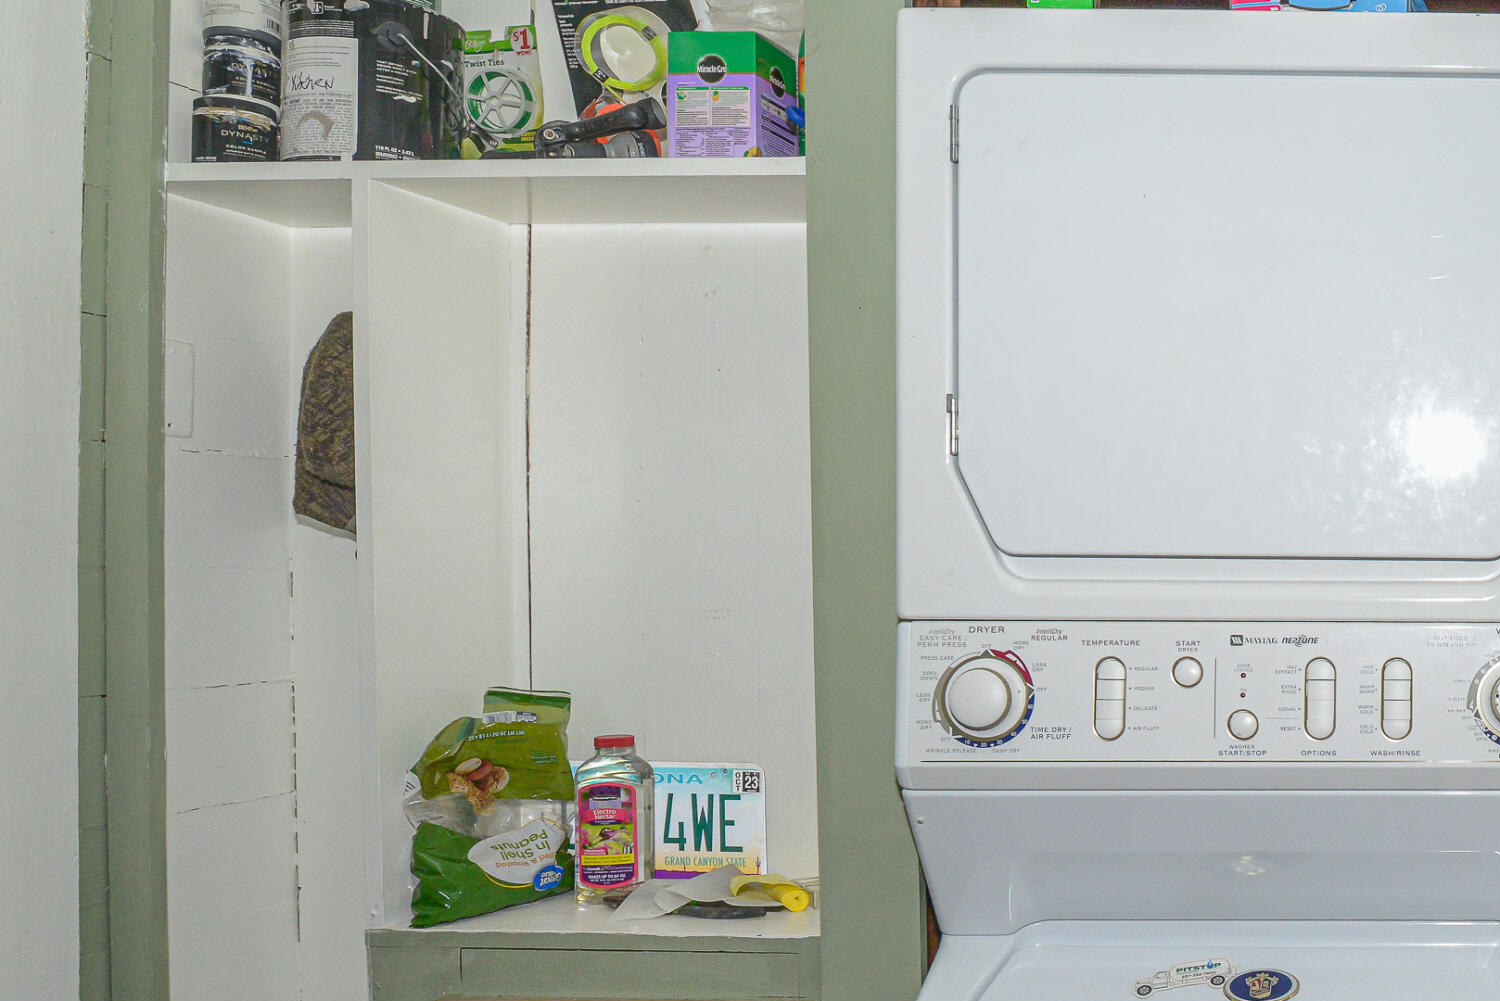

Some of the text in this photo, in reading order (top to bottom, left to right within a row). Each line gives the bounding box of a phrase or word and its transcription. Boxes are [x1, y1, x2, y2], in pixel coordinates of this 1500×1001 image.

[512, 28, 531, 50] $1
[464, 58, 505, 68] Twist Ties
[220, 129, 269, 143] DYNASTY
[968, 625, 1006, 634] DRYER
[1369, 749, 1422, 757] WASH/RINSE
[744, 775, 759, 790] 23
[663, 792, 744, 853] 4WE
[490, 828, 549, 851] Peanuts
[500, 840, 551, 860] In Shell
[664, 855, 747, 868] GRAND CANYON STATE
